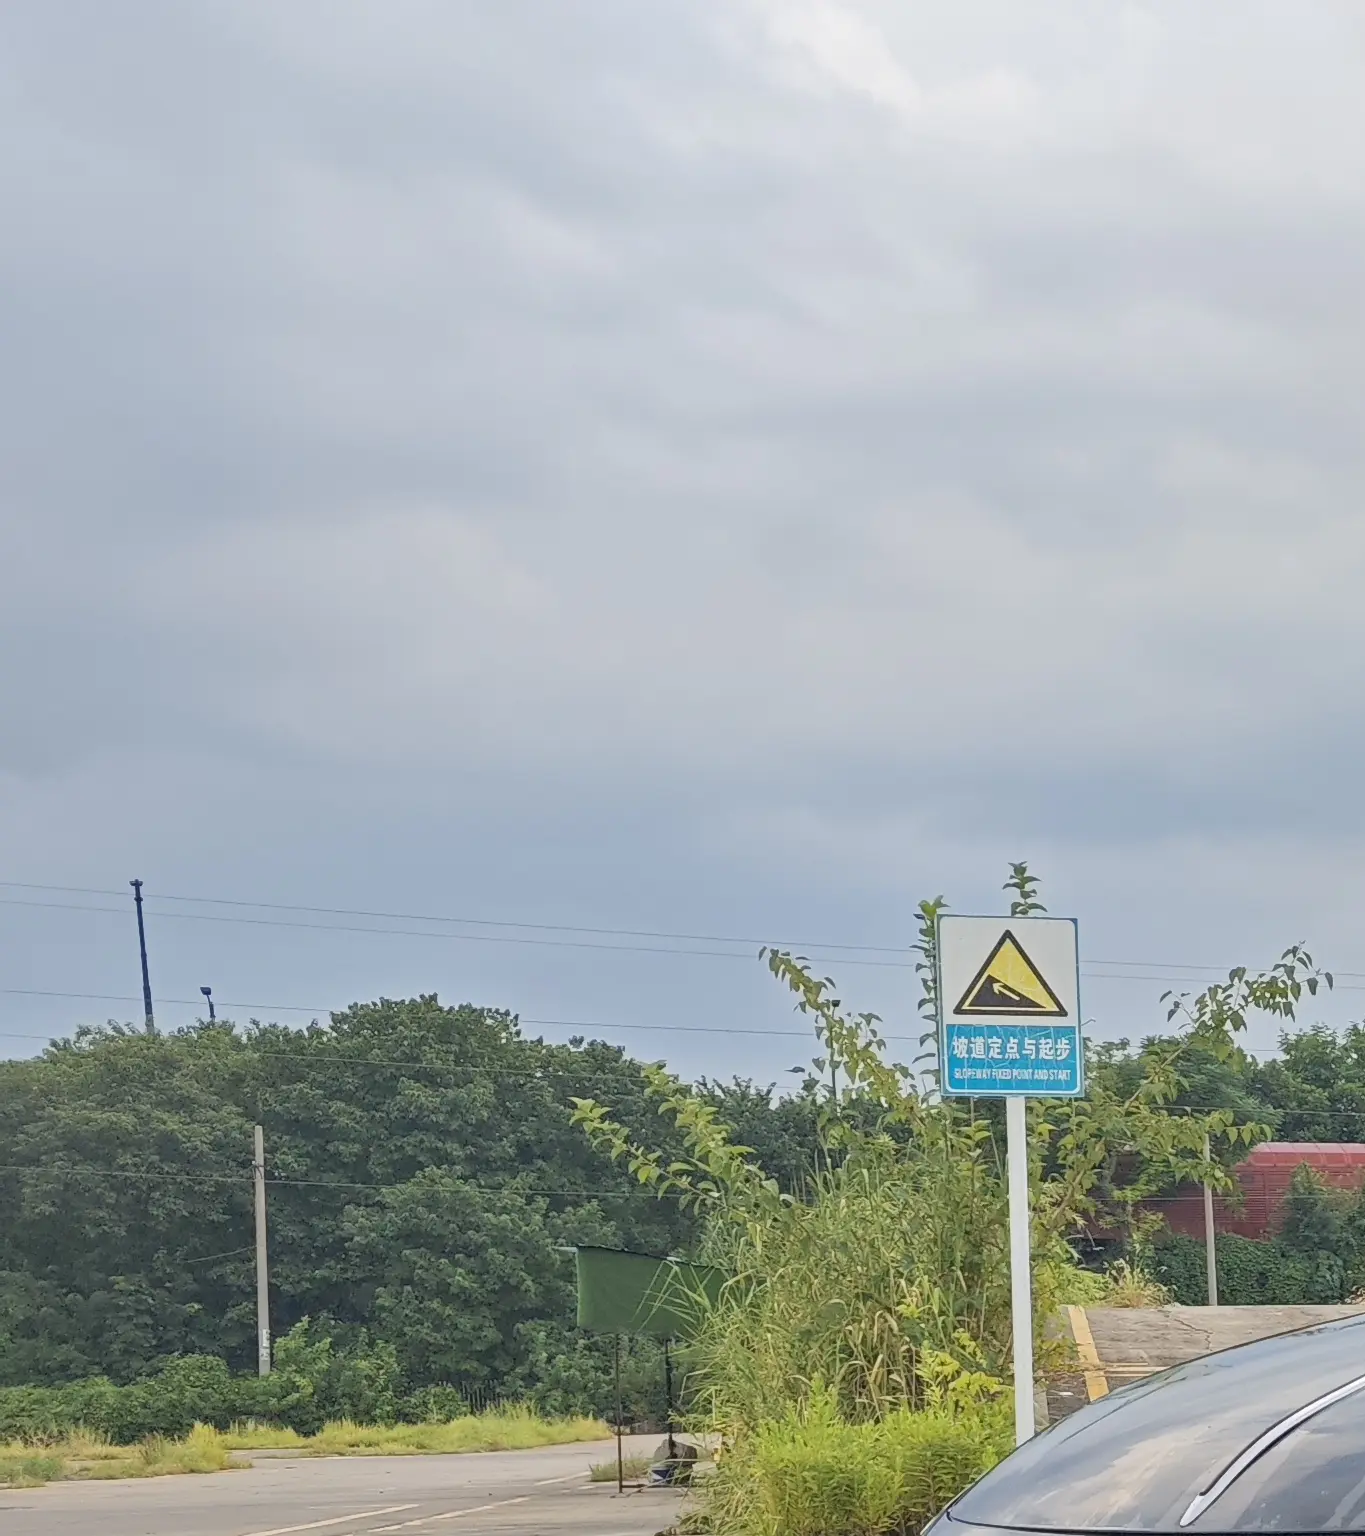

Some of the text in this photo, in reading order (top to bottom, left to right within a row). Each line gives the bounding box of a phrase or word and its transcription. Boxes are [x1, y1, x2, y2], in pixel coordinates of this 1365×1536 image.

[952, 1036, 1071, 1060] 坡道定点与起步
[1012, 1069, 1033, 1079] POINT
[1034, 1069, 1048, 1080] AND
[1049, 1069, 1071, 1080] START
